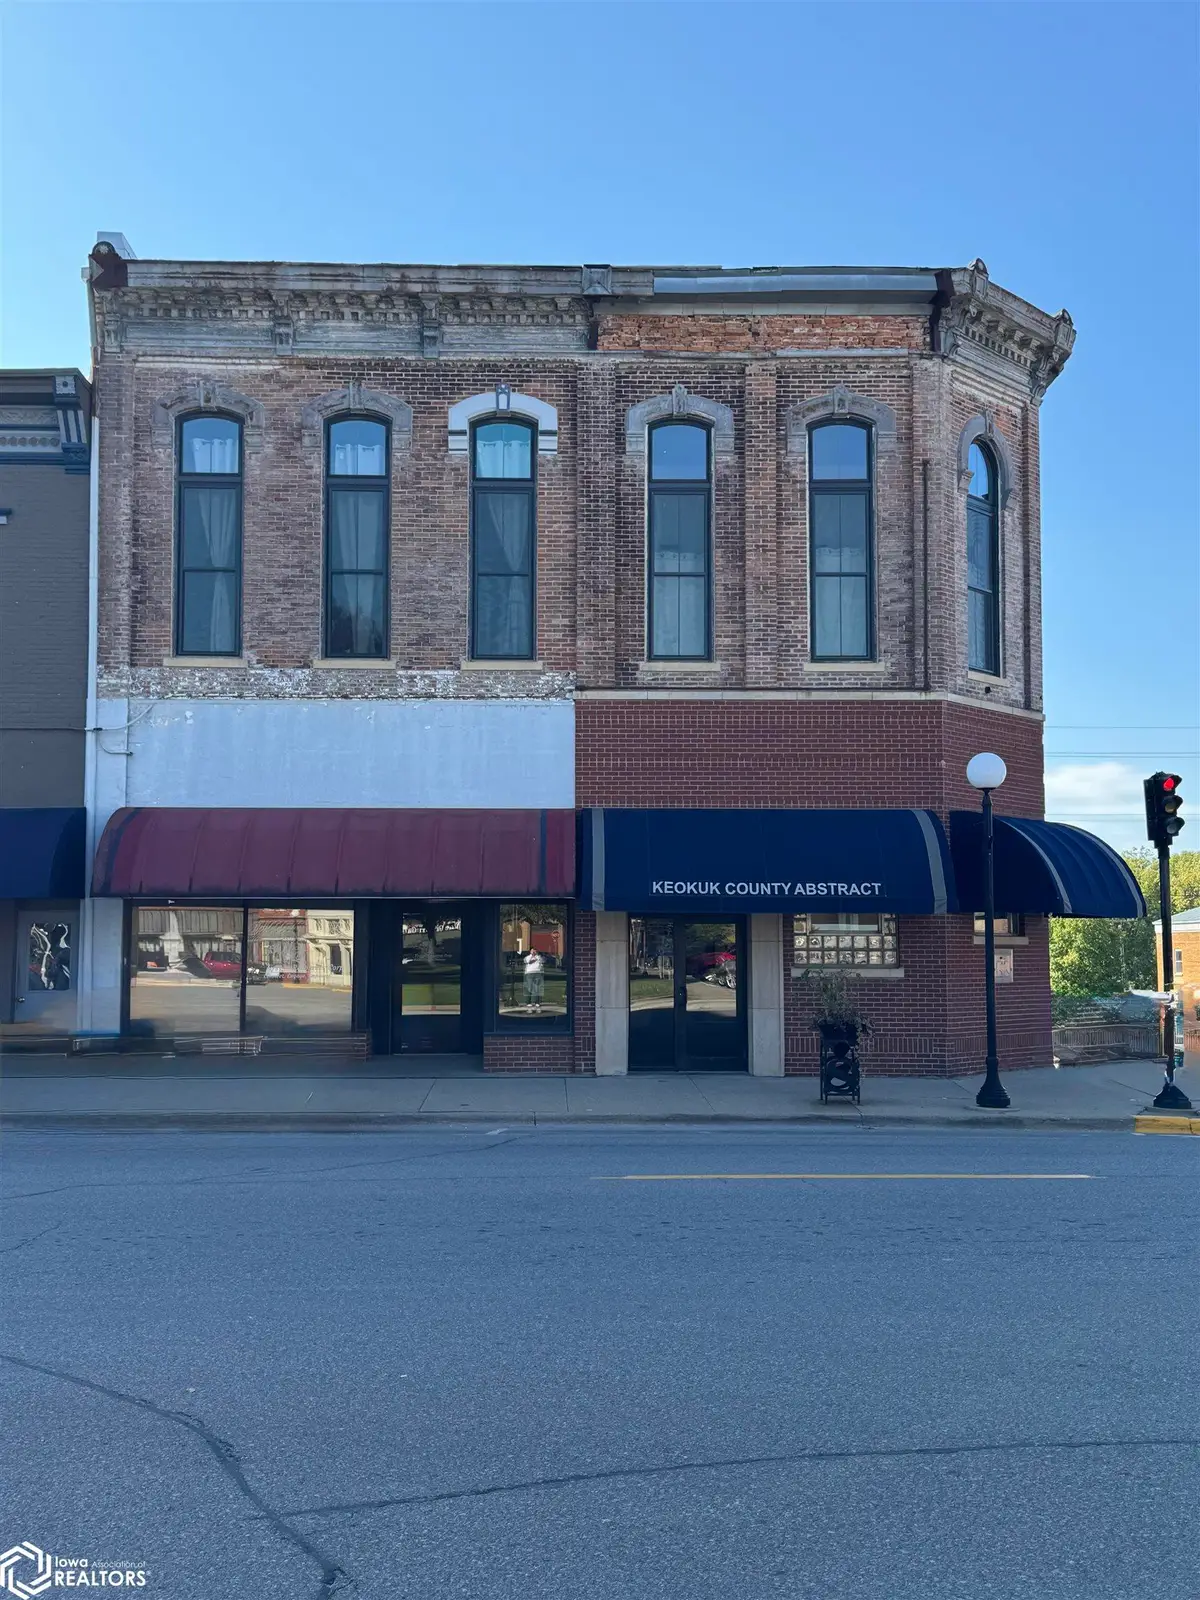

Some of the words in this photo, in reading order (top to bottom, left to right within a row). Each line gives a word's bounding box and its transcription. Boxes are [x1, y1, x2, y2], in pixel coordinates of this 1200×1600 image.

[652, 881, 721, 895] KEOKUK
[724, 882, 792, 895] COUNTY
[794, 882, 882, 896] ABSTRACT
